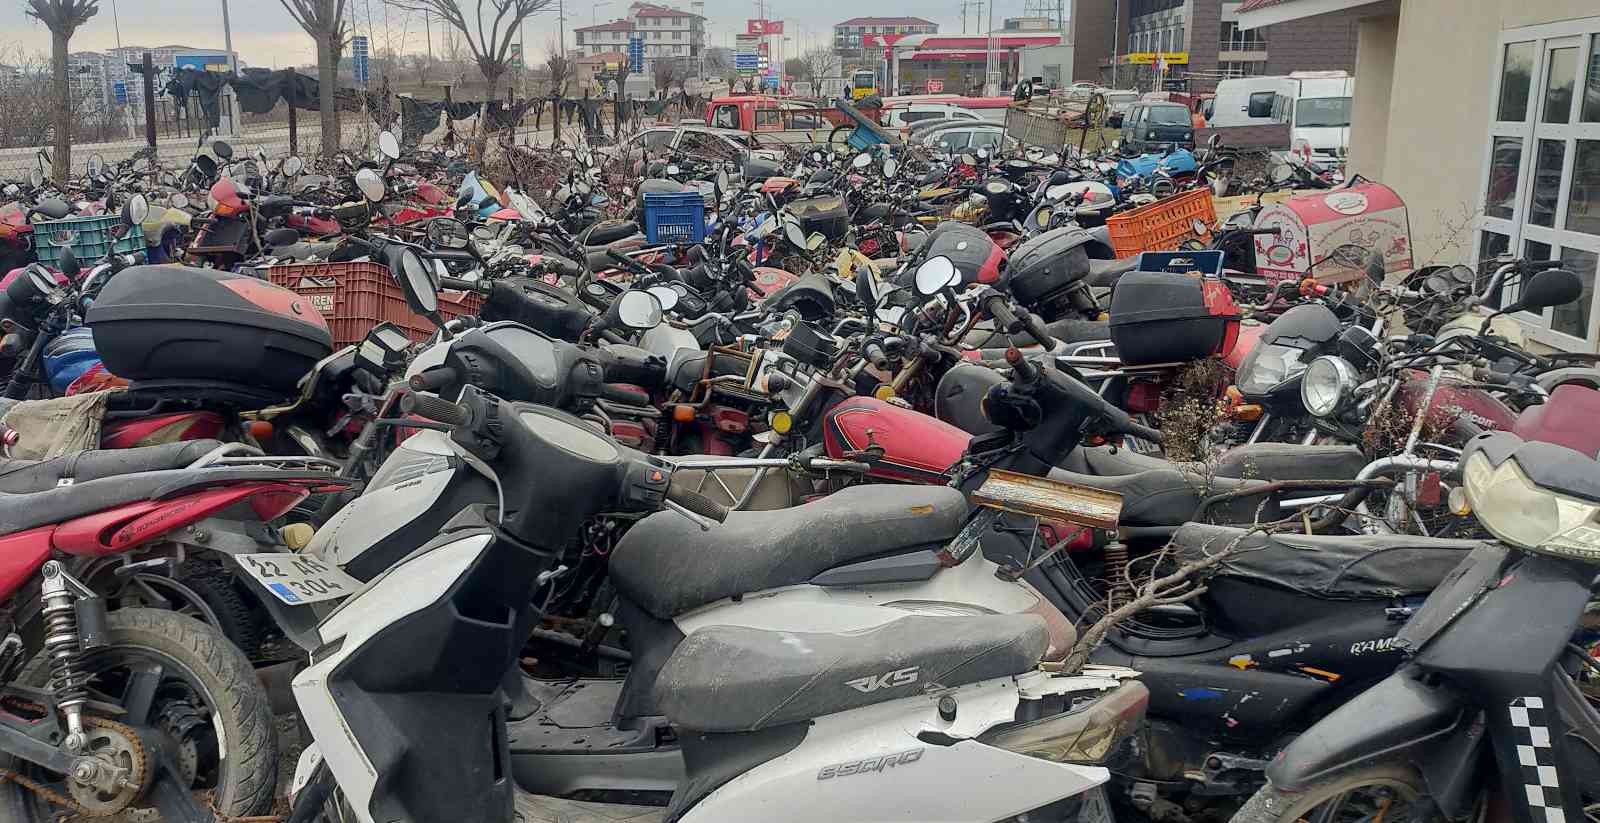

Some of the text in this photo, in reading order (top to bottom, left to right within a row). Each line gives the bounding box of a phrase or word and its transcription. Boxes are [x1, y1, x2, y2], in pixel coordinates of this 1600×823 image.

[247, 559, 288, 577] 22
[289, 578, 343, 596] 304
[844, 666, 920, 693] RKS
